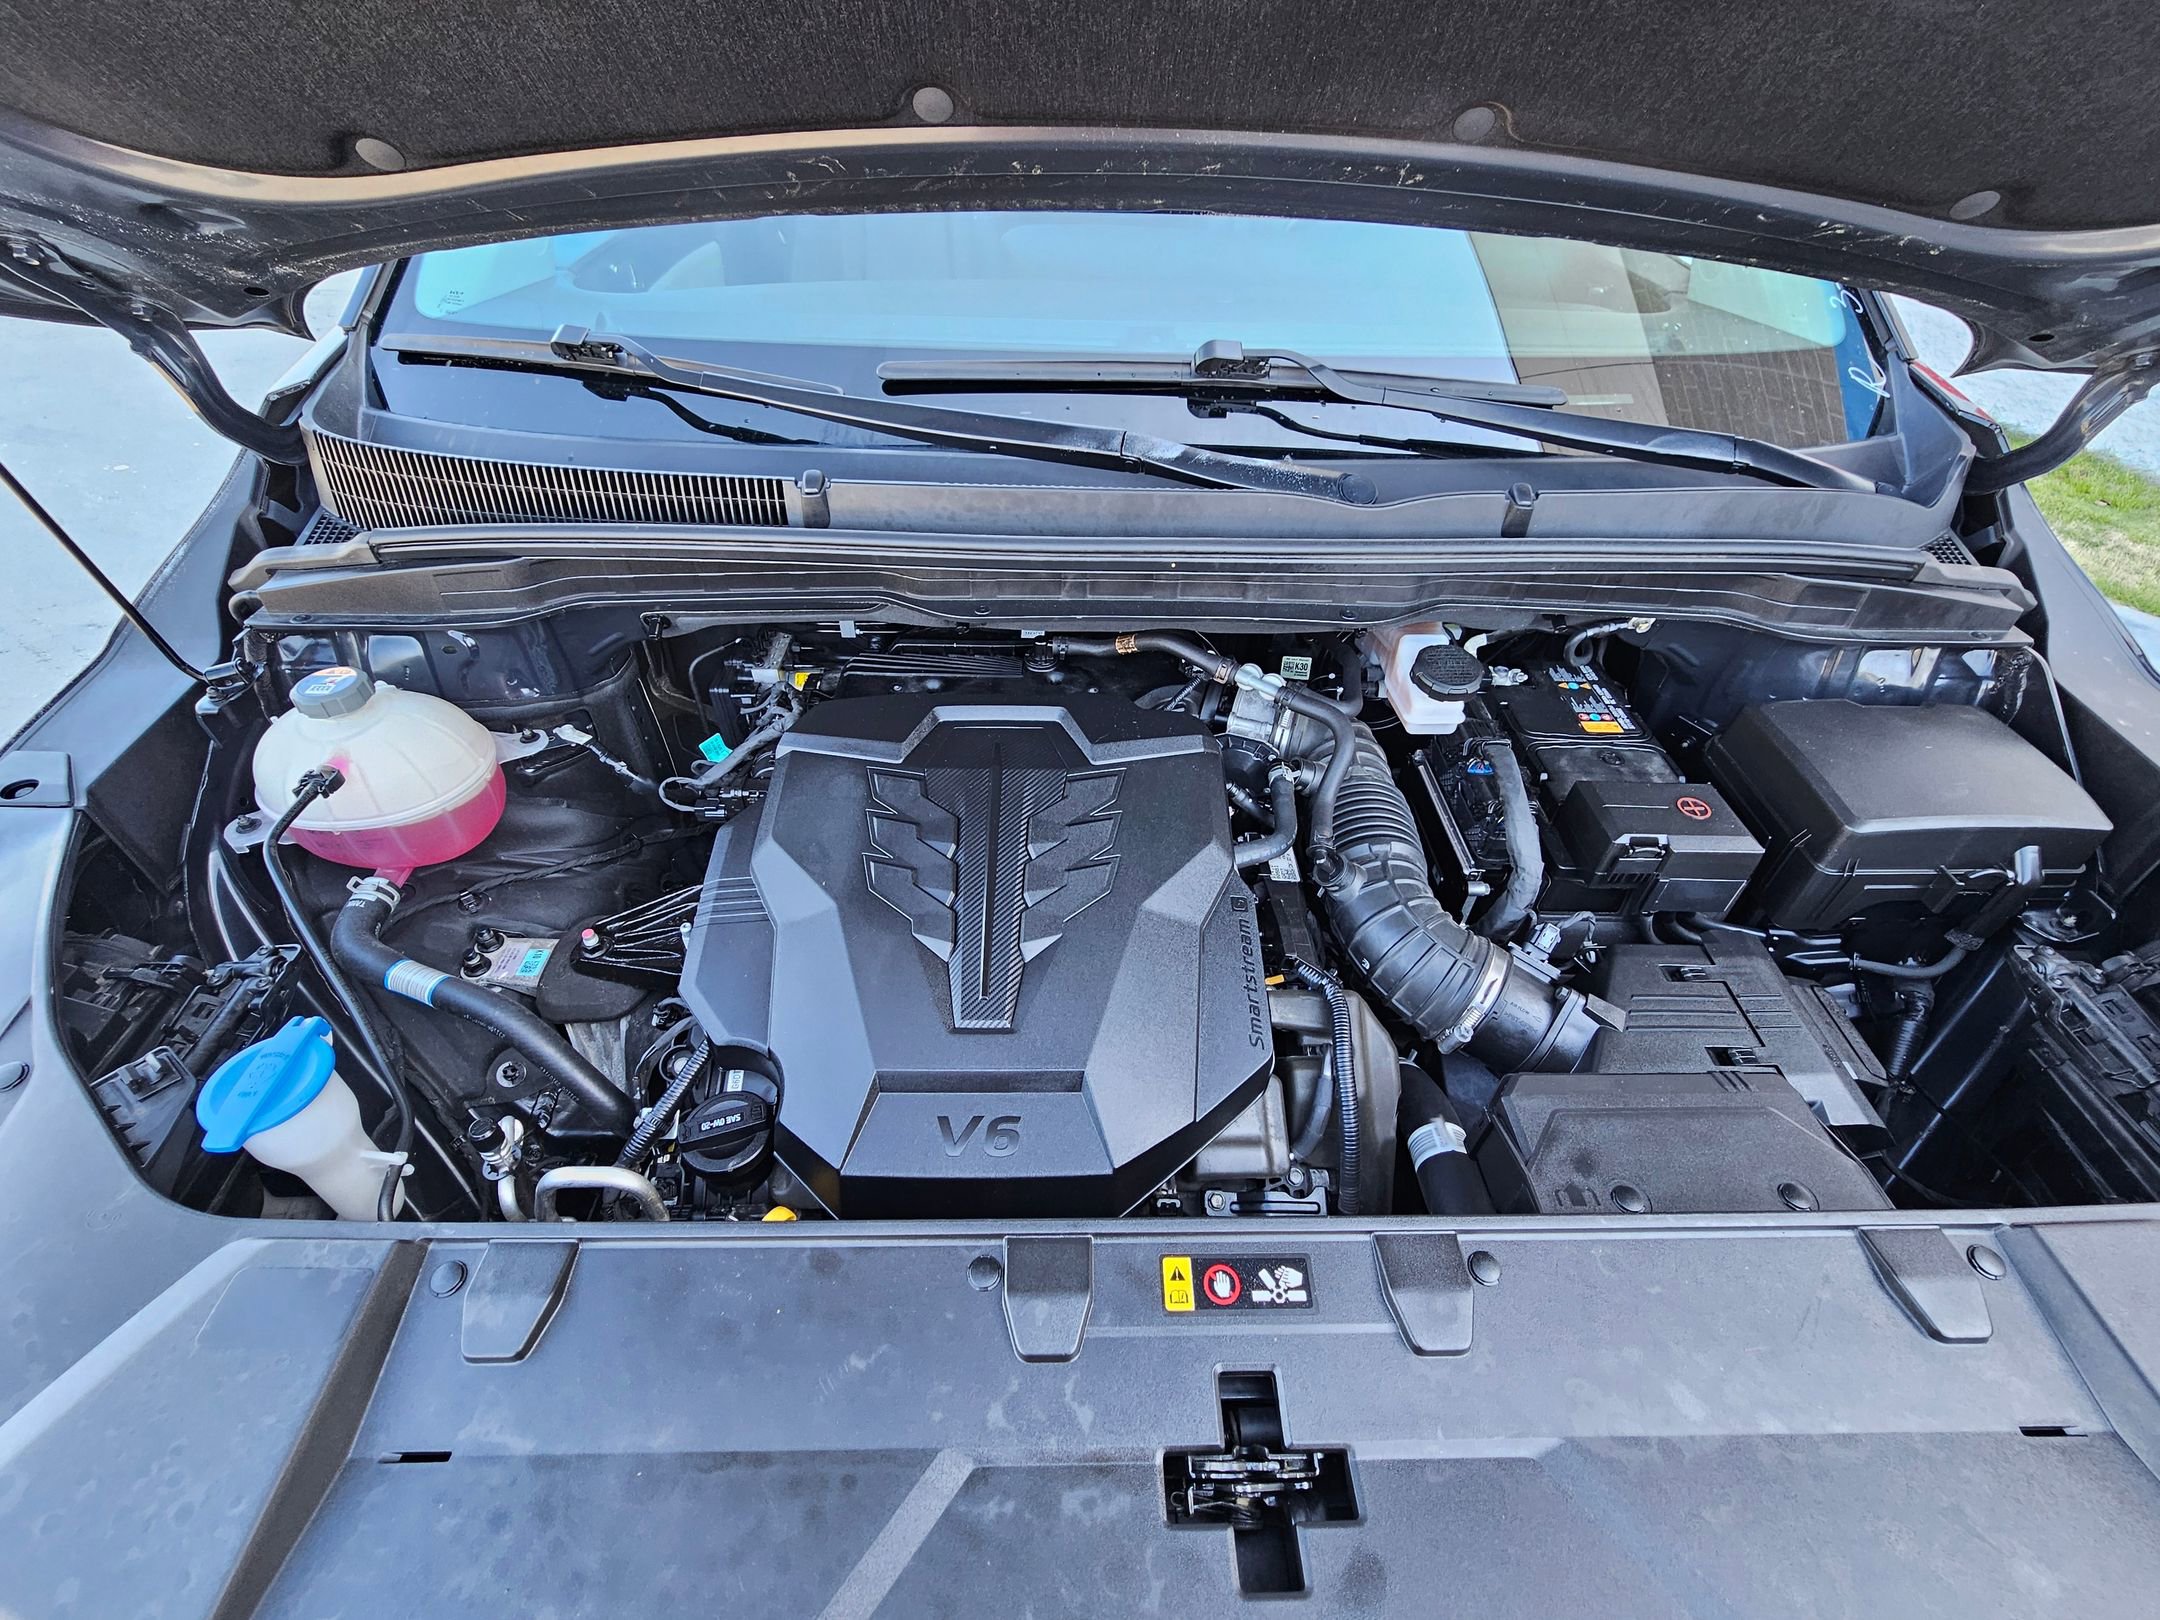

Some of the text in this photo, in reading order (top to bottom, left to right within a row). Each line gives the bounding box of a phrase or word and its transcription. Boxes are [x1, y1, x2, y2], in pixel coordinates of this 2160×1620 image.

[1294, 661, 1309, 671] K30
[1238, 918, 1265, 1051] Smartstream
[701, 1113, 741, 1131] SAE 0W-20
[937, 1115, 1022, 1158] V6
